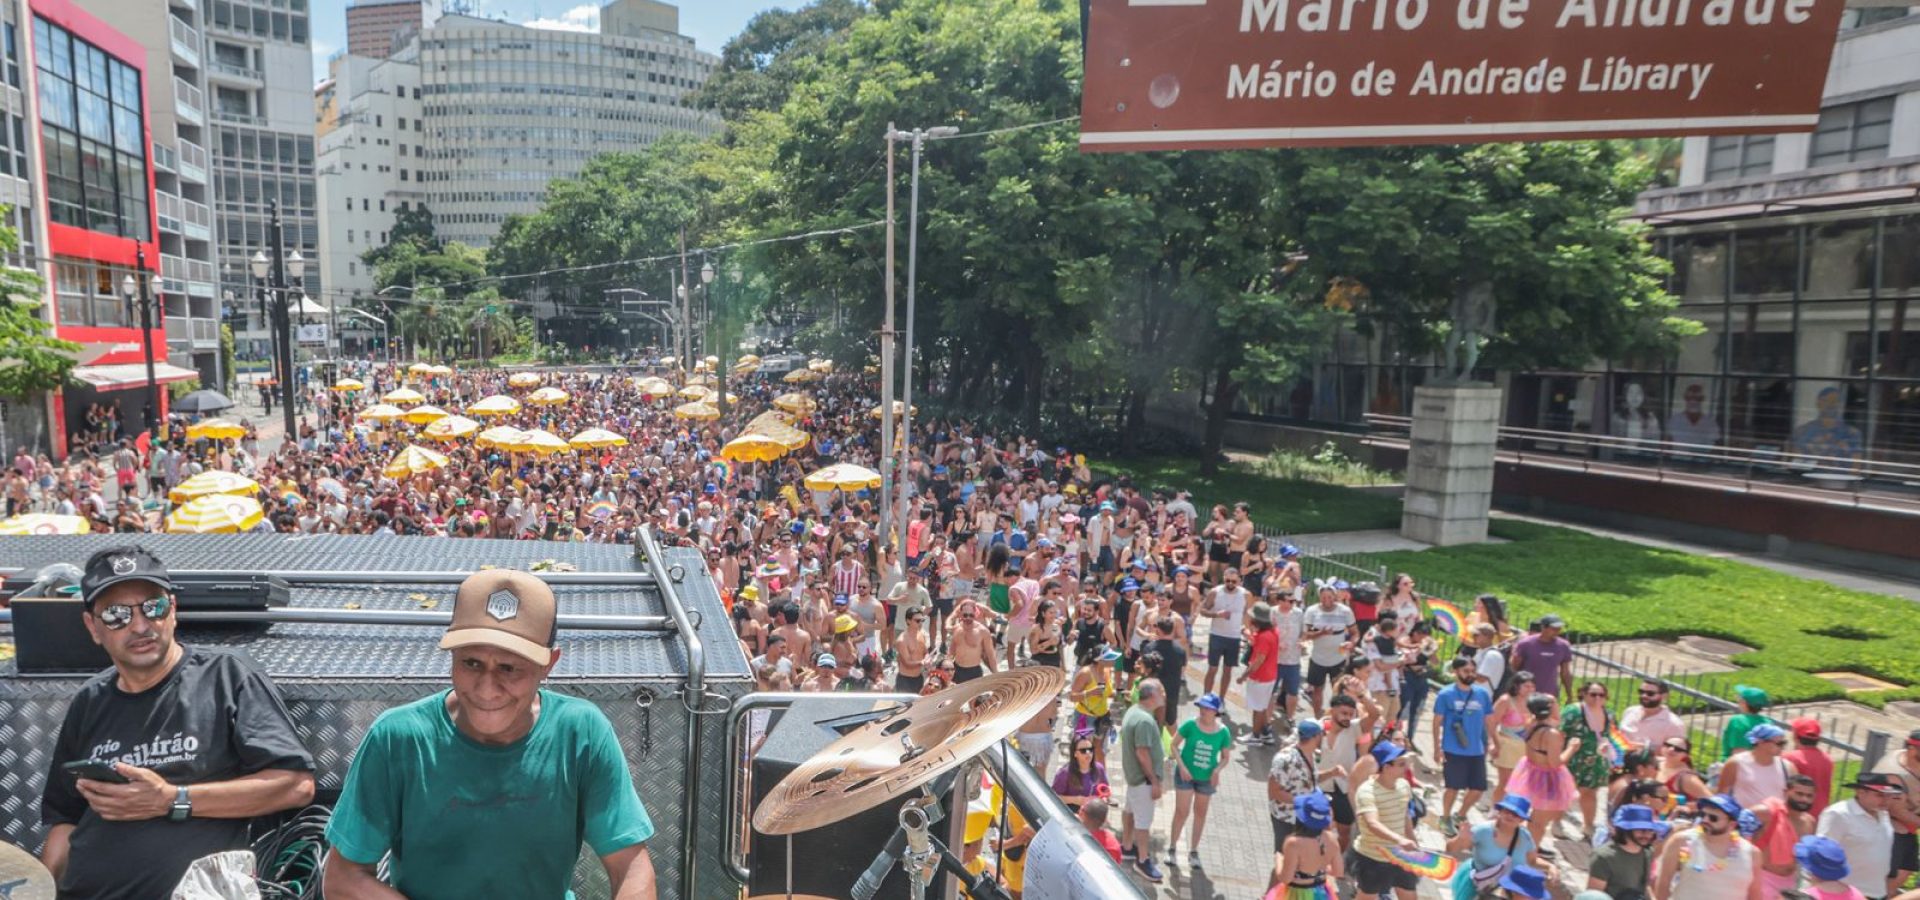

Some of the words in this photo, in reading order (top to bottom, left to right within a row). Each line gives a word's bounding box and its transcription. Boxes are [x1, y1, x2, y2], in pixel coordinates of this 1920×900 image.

[1457, 0, 1529, 30] de
[1555, 0, 1814, 28] Andrade
[1226, 59, 1337, 99] Mário
[1350, 60, 1397, 97] de
[1409, 57, 1567, 96] Andrade
[1578, 56, 1714, 100] Library
